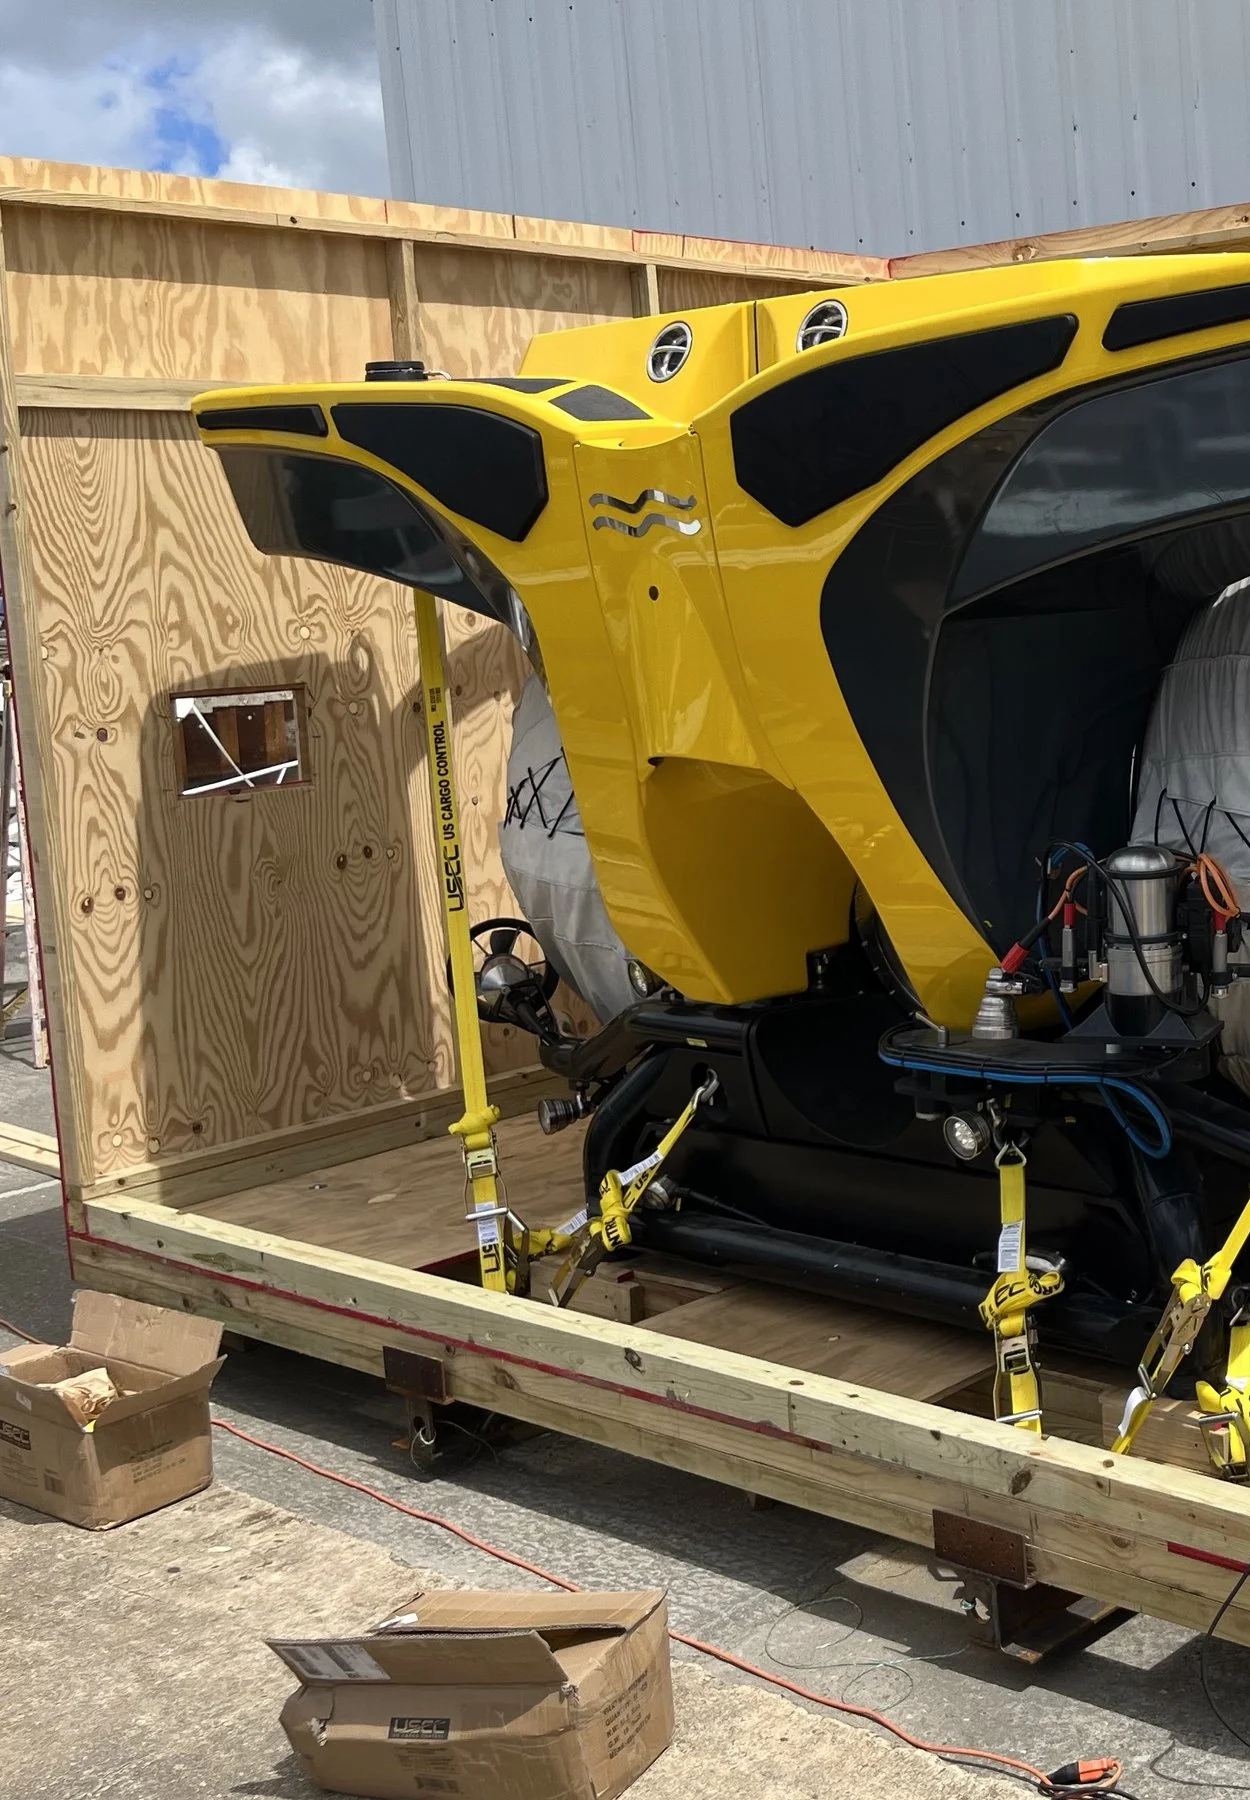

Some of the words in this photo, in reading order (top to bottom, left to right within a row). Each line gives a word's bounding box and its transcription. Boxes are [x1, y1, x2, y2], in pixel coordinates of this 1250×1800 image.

[432, 721, 449, 777] CONTROL
[438, 779, 454, 820] CARGO
[443, 823, 455, 840] US
